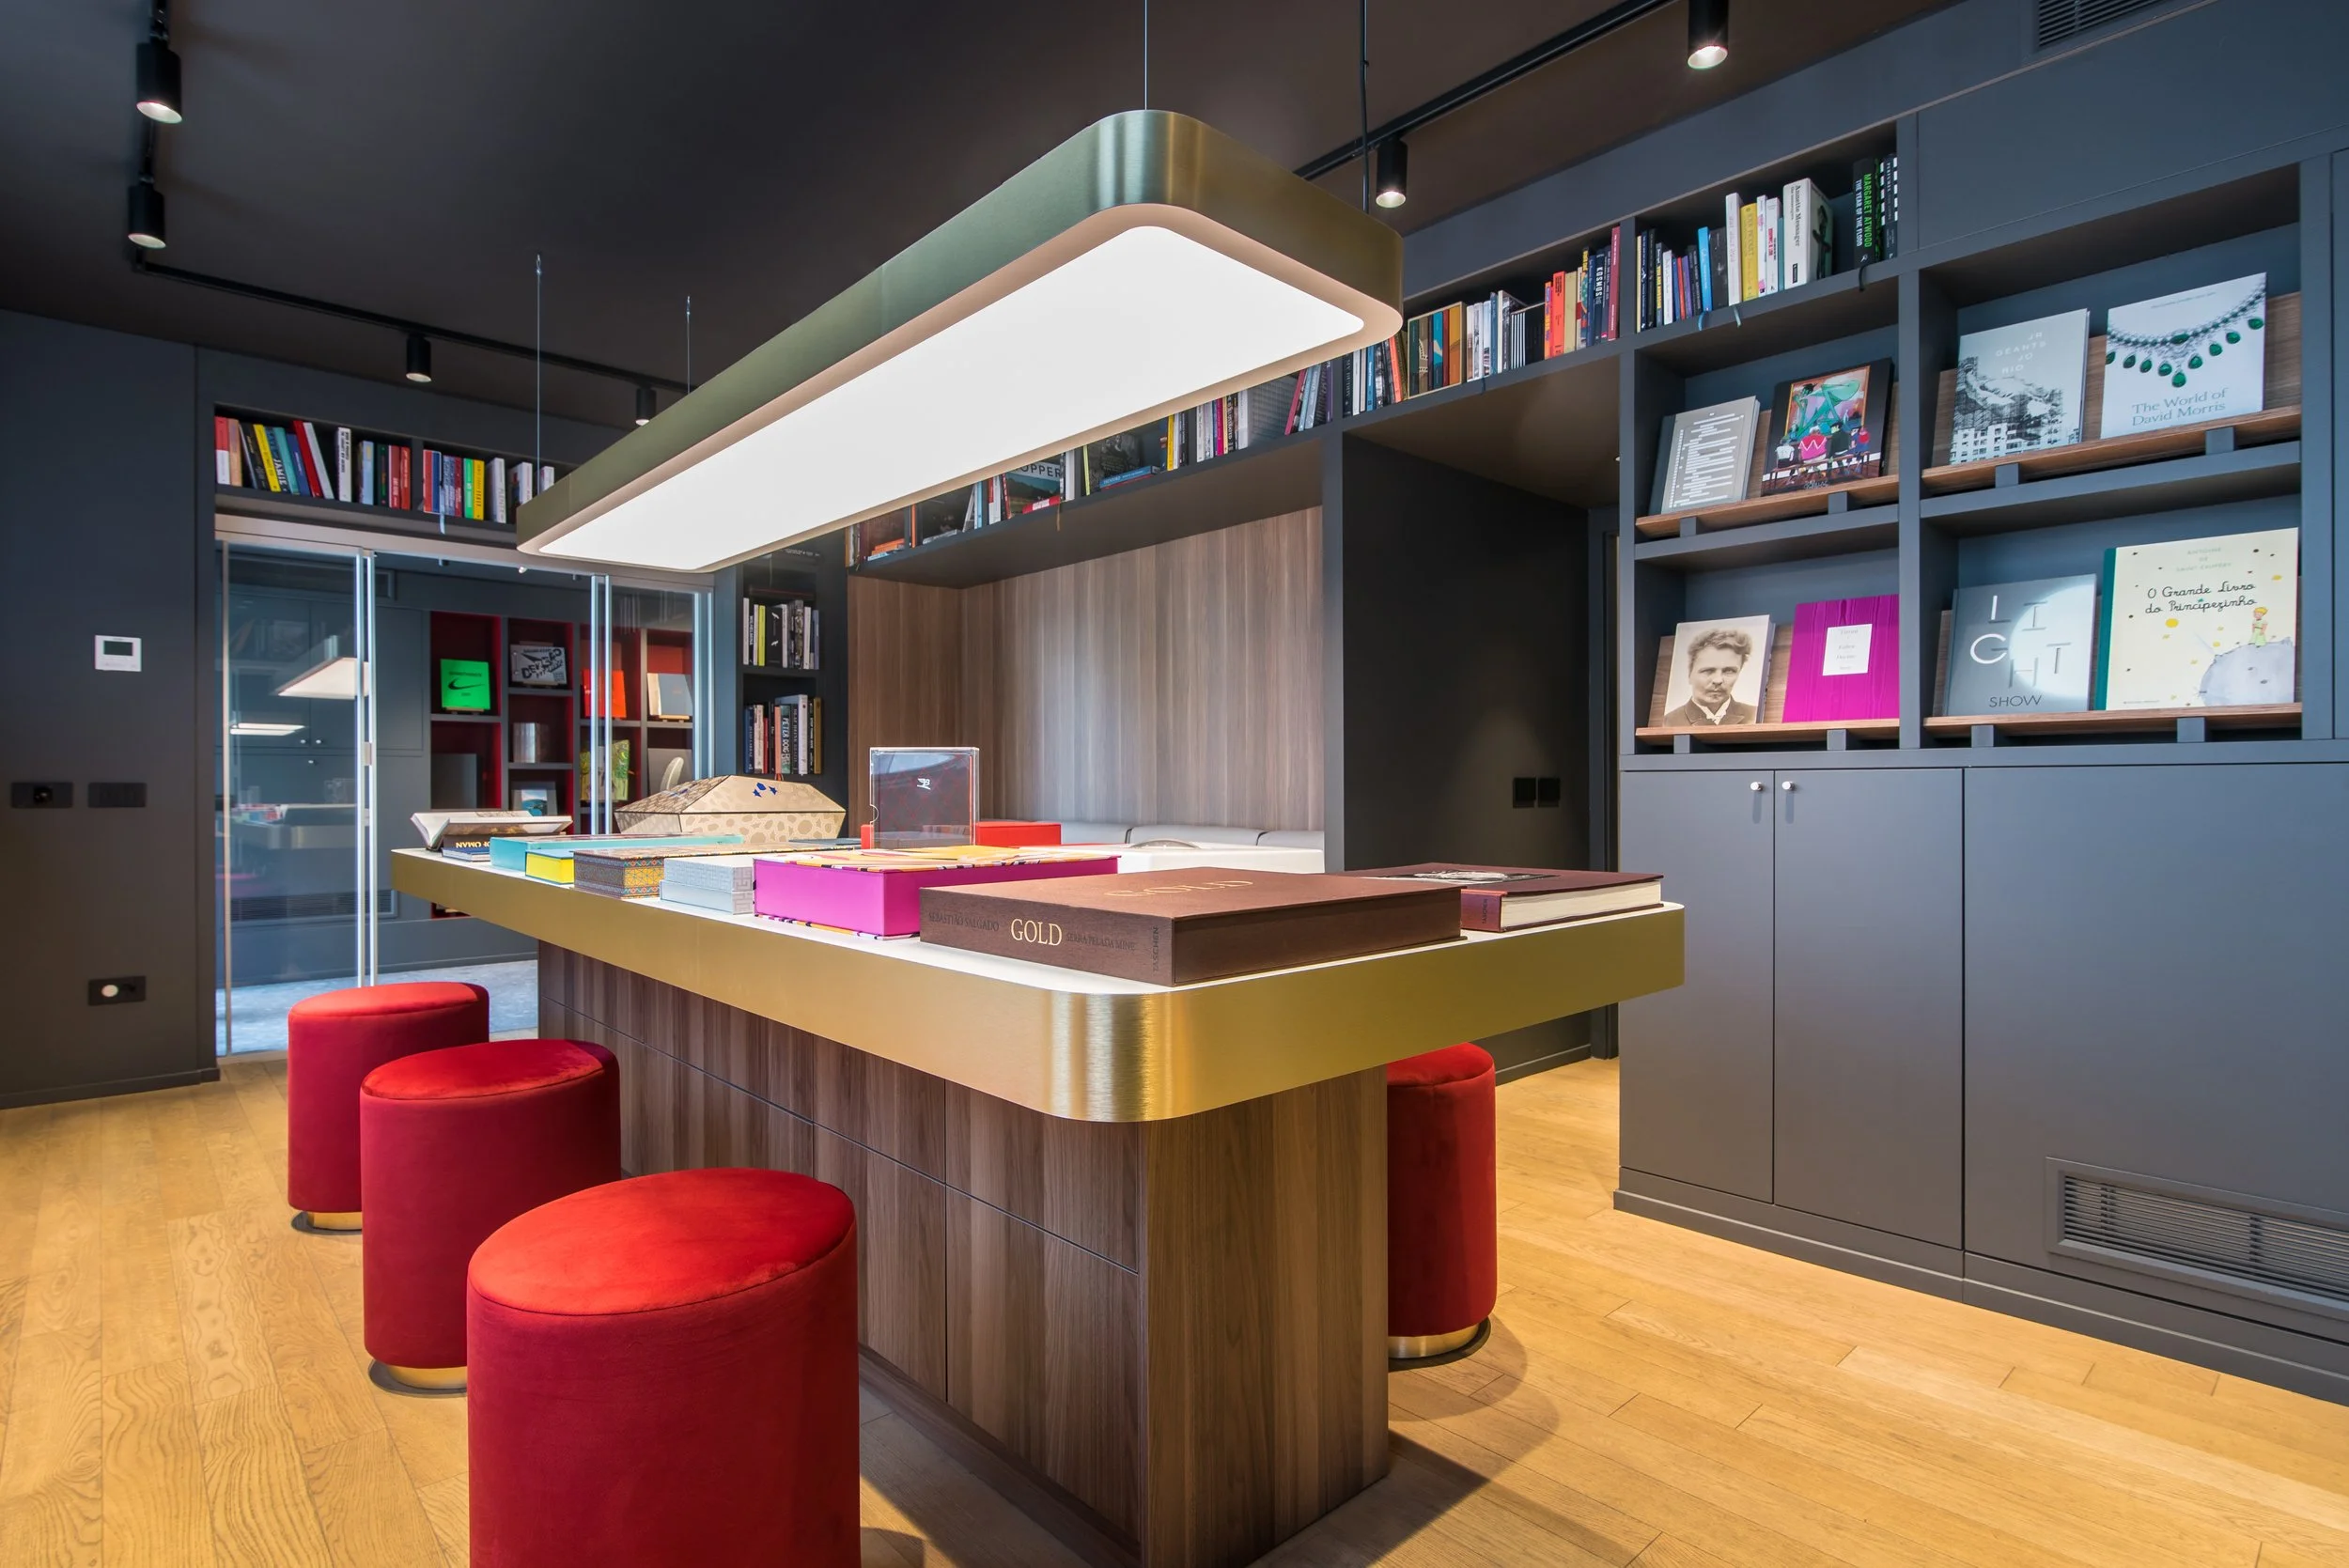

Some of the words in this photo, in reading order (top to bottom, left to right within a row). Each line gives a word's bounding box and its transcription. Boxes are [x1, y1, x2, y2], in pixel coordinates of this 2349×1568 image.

[1863, 173, 1872, 214] MARGARET
[1863, 216, 1873, 248] ATWOOD
[1595, 266, 1604, 297] KOSMOS
[2132, 403, 2160, 414] The
[2164, 392, 2208, 408] World
[2211, 387, 2229, 399] of
[2132, 410, 2172, 427] David
[2177, 401, 2227, 419] Morris
[273, 458, 288, 486] JAMIE
[1017, 462, 1062, 478] OPPER
[2147, 587, 2157, 599] O
[2162, 584, 2212, 598] Grande
[2217, 581, 2256, 593] Livro
[2145, 603, 2163, 613] do
[2169, 595, 2258, 613] Principezinho
[1989, 694, 2043, 708] SHOW
[456, 841, 482, 849] OMAN
[1010, 918, 1063, 946] GOLD
